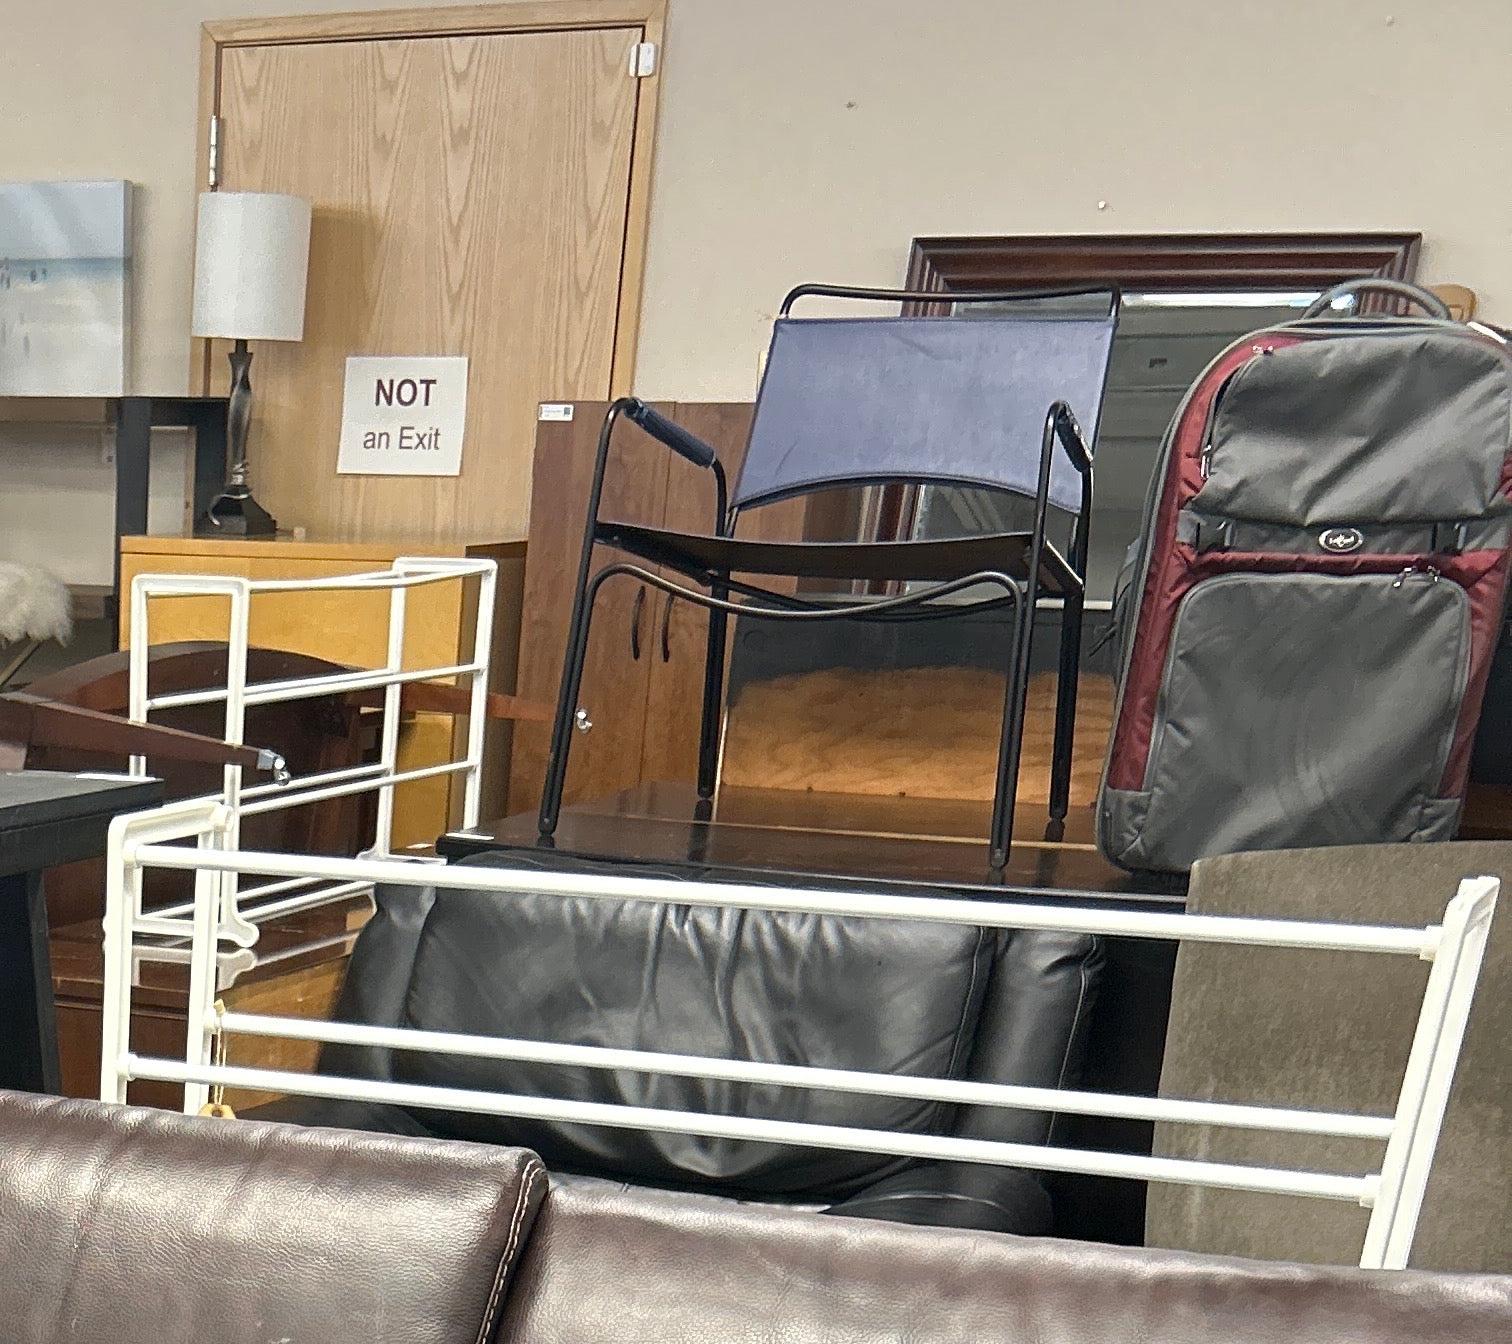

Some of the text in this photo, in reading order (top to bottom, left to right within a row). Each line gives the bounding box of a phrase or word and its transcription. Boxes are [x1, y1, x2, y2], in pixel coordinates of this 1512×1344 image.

[375, 379, 437, 406] NOT
[363, 426, 440, 450] an Exit
